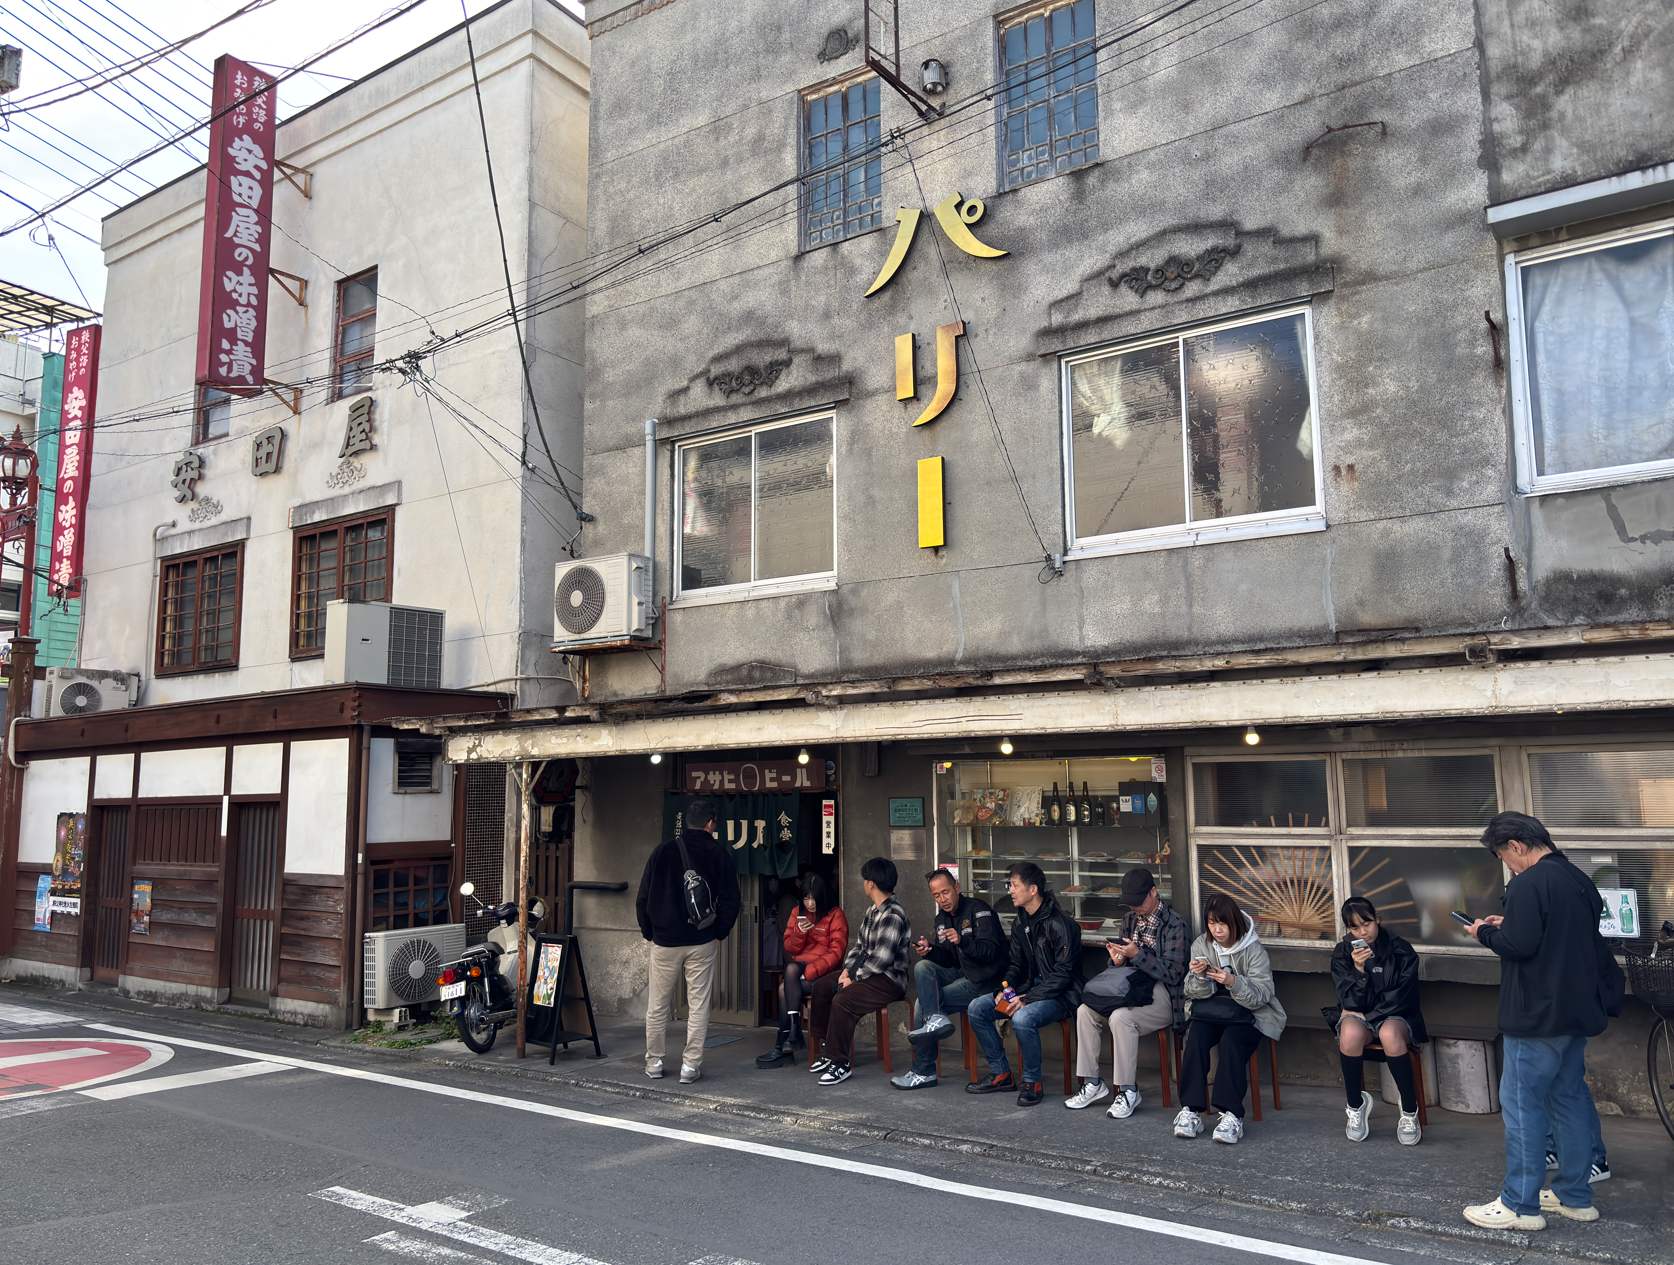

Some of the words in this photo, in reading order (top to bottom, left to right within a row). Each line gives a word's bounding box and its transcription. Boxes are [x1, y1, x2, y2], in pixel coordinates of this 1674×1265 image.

[233, 70, 248, 128] おみやげ
[218, 134, 268, 385] 安田屋の味噌漬
[864, 190, 1010, 548] パリー
[53, 386, 87, 592] 安田屋の味噌漬
[170, 395, 375, 503] 安田屋
[691, 770, 736, 790] アサヒ
[764, 767, 812, 788] ビール
[777, 810, 793, 841] 食堂
